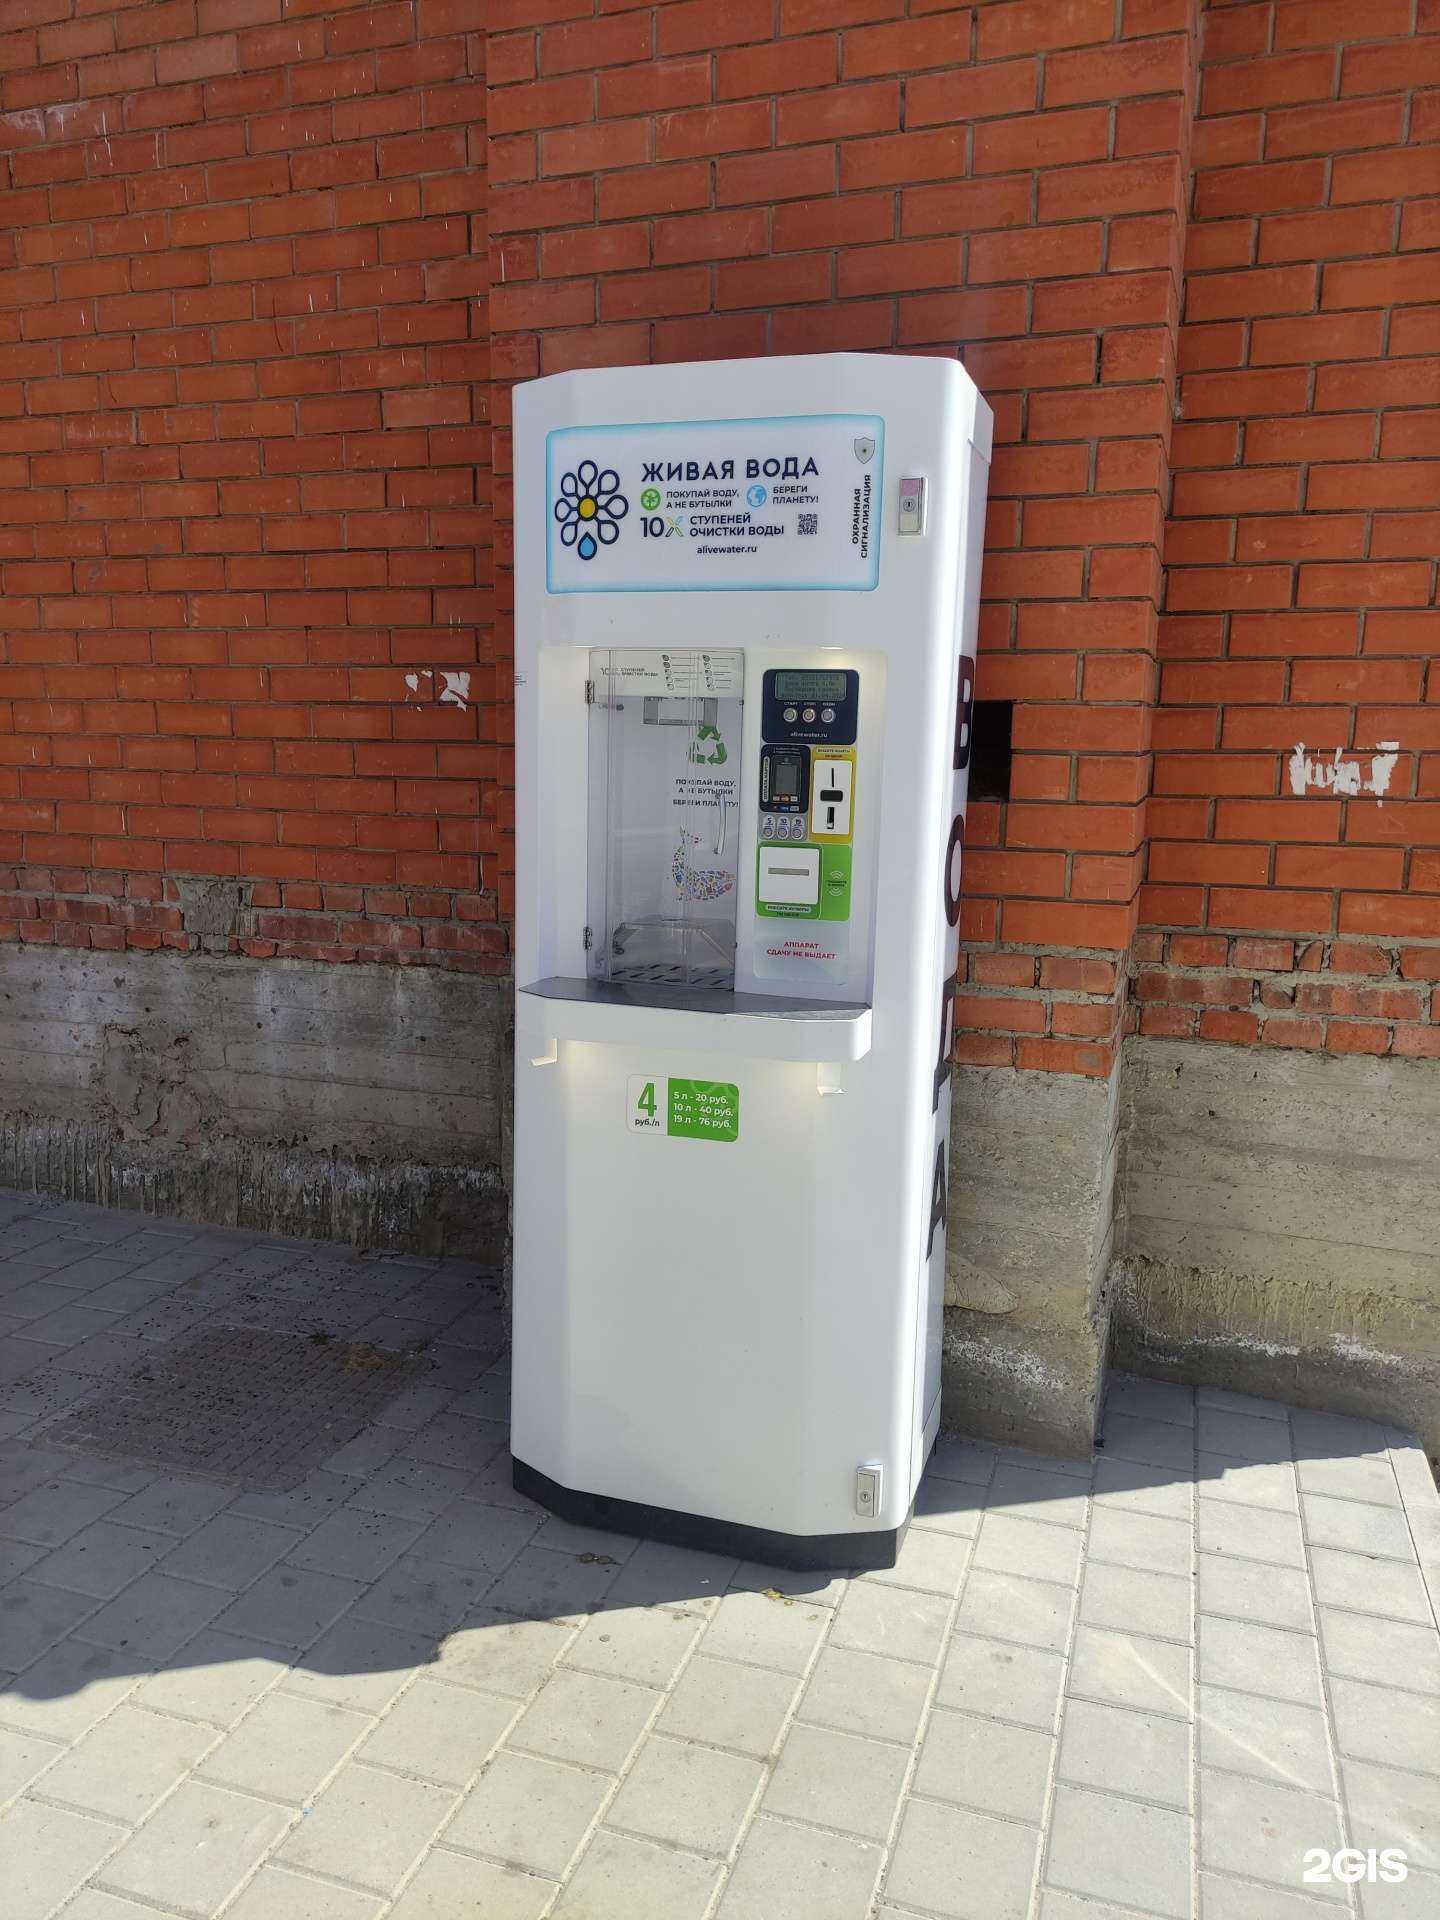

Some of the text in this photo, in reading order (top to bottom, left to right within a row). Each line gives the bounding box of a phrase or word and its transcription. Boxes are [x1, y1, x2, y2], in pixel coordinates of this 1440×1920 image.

[641, 456, 819, 482] ЖИВАЯ ВОДА
[666, 488, 740, 499] ПОКУПАЙ ВОДУ,
[773, 485, 808, 494] БЕРЕГИ
[689, 500, 732, 508] БУТЫЛКИ
[772, 496, 819, 505] ПЛАНЕТУ!
[690, 512, 751, 525] СТУПЕНЕЙ
[852, 488, 861, 545] ОХРАННАЯ
[861, 474, 871, 559] СИГНАЛИЗАЦИЯ
[690, 525, 784, 537] ОЧИСТКИ ВОДЫ
[697, 544, 757, 554] alivewater.ru
[784, 941, 819, 949] АППАРАТ
[638, 1082, 657, 1117] 4
[695, 1093, 707, 1102] 20
[709, 1096, 729, 1105] руб.
[673, 1103, 683, 1111] 10
[699, 1105, 712, 1113] 40
[714, 1107, 733, 1117] руб.
[634, 1118, 660, 1127] руб./л
[673, 1114, 682, 1123] 19
[699, 1117, 710, 1126] 76
[712, 1119, 731, 1128] руб.
